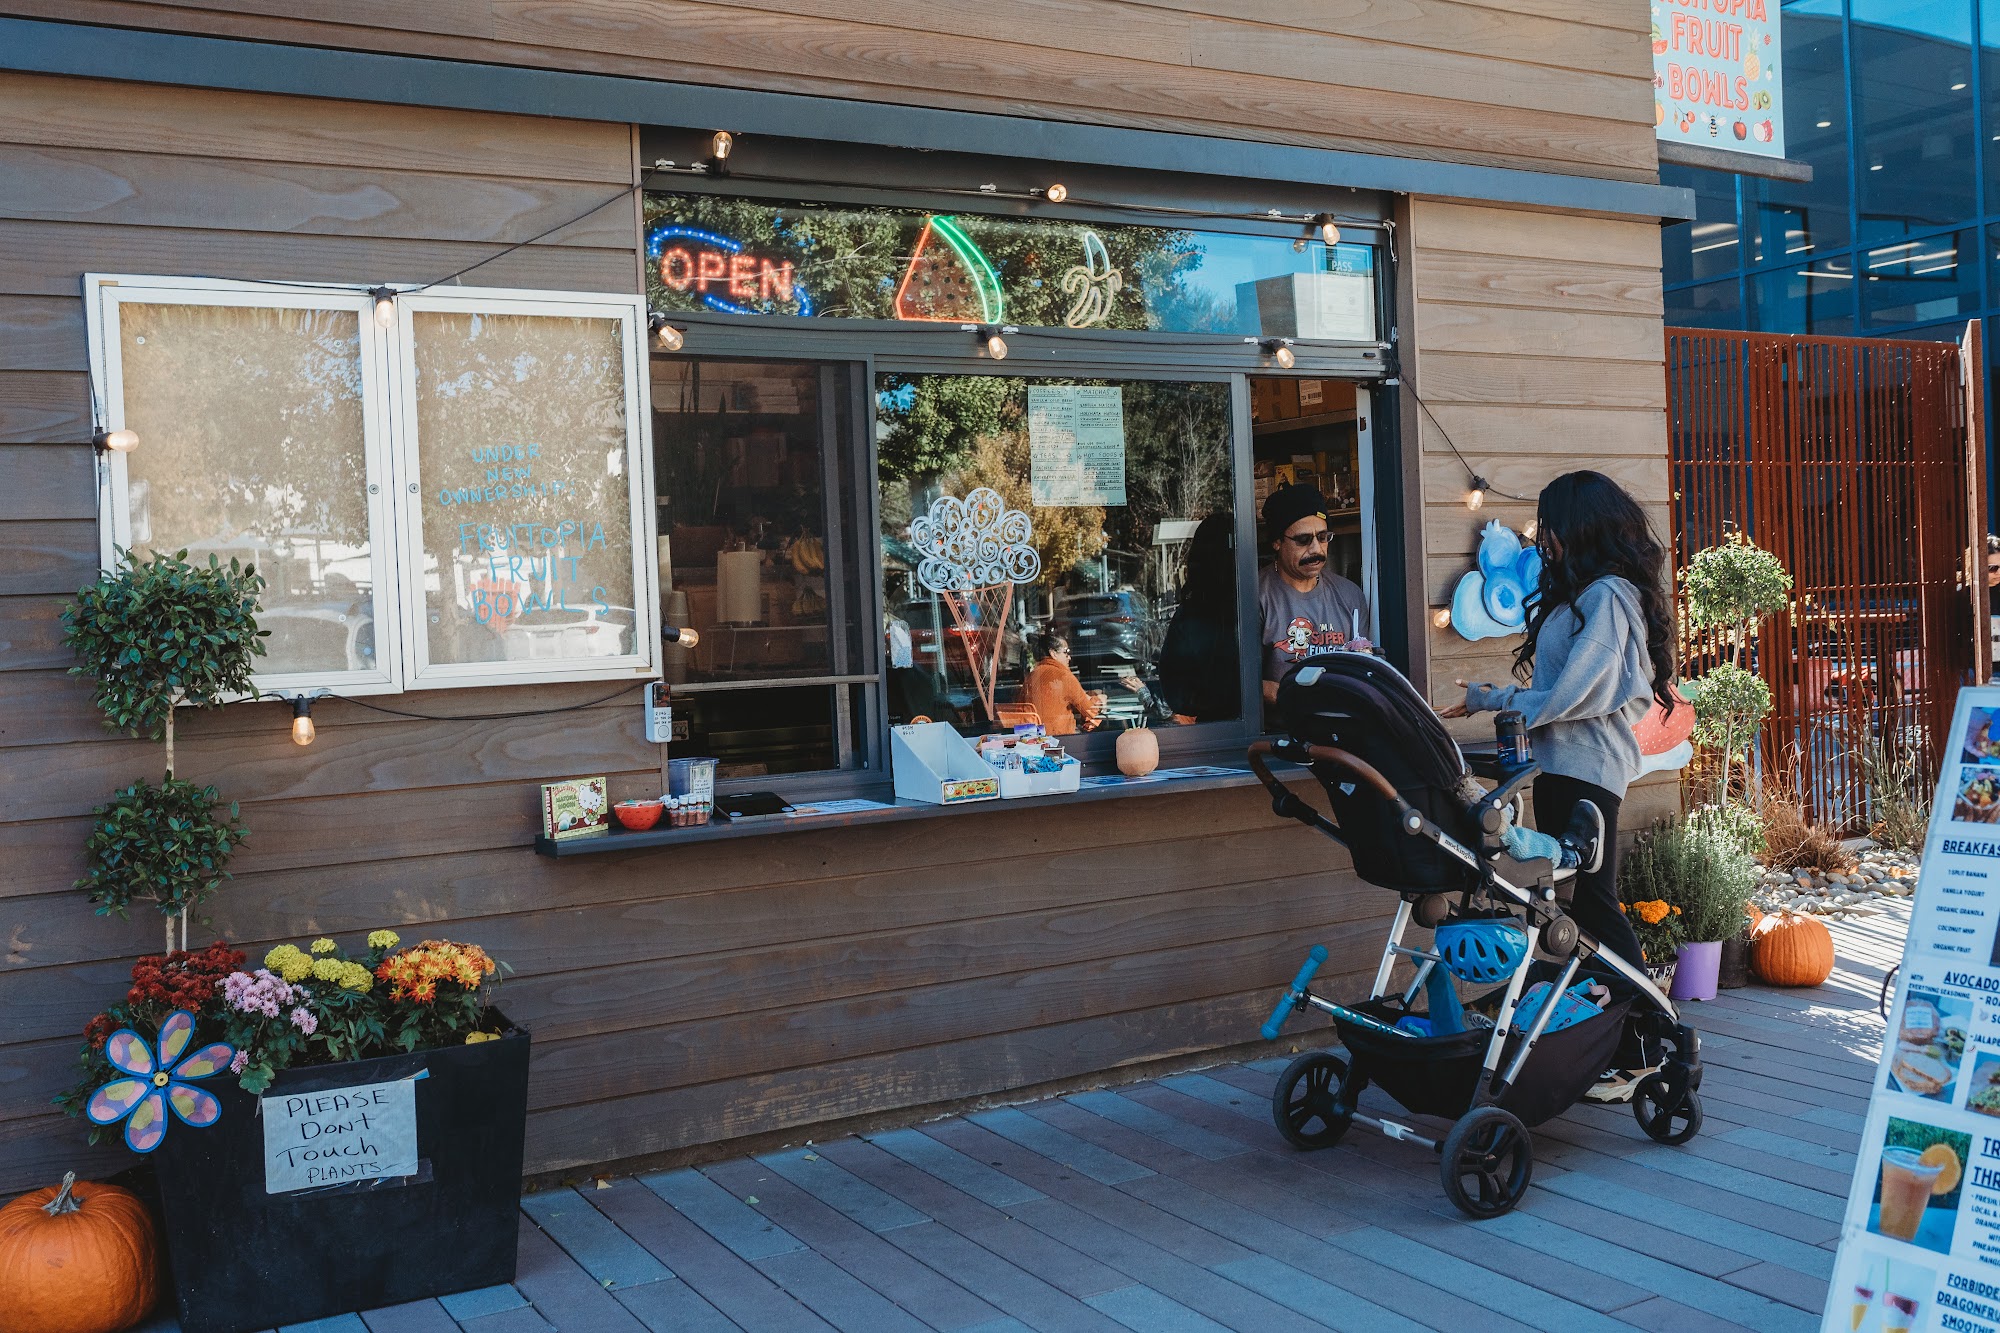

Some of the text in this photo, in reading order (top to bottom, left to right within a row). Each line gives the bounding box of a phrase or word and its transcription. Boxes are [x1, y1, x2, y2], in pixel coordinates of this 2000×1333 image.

[1671, 12, 1742, 61] FRUIT
[1668, 63, 1749, 111] BOWLS
[661, 248, 793, 300] OPEN
[1332, 260, 1353, 272] PASS
[471, 443, 541, 463] UNDER
[486, 464, 532, 483] NEW
[439, 480, 576, 506] OWNERSHIP:
[458, 519, 607, 554] FRUITOPIA
[489, 555, 583, 583] FRUIT
[472, 586, 609, 625] BOWLS
[1444, 839, 1478, 863] mockingbir
[1964, 889, 1985, 897] YOGURT
[1936, 906, 1985, 917] ORGANIC GRANOLA
[1937, 925, 1962, 934] COCONUT
[1933, 943, 1955, 952] ORGANIC
[1909, 983, 1970, 999] EVERYTHING SEASONING
[1944, 971, 1999, 991] AVOCADO
[286, 1089, 390, 1118] PLEASE
[275, 1136, 378, 1168] Touch
[307, 1162, 382, 1184] PLANTS
[1971, 1205, 1990, 1216] LOCAL
